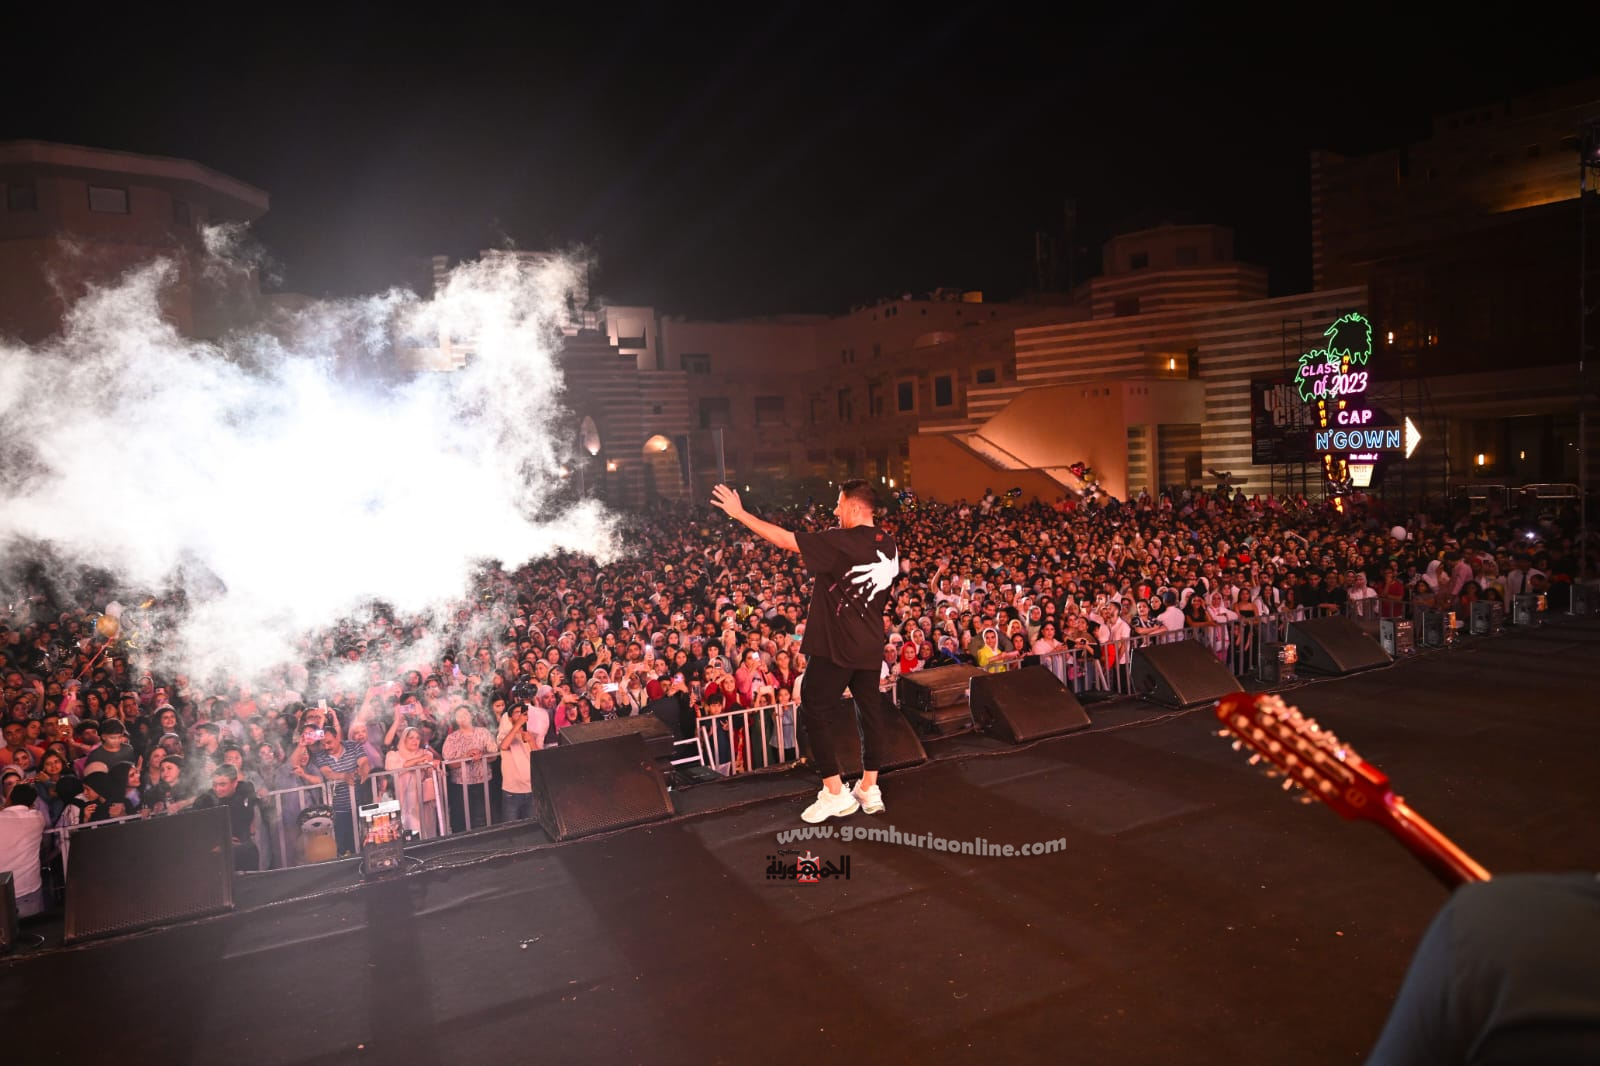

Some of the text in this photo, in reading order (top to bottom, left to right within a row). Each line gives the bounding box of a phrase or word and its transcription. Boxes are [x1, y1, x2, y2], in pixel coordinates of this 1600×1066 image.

[1301, 364, 1338, 377] CLASS
[1314, 372, 1367, 395] of 2023
[1338, 410, 1372, 424] CAP
